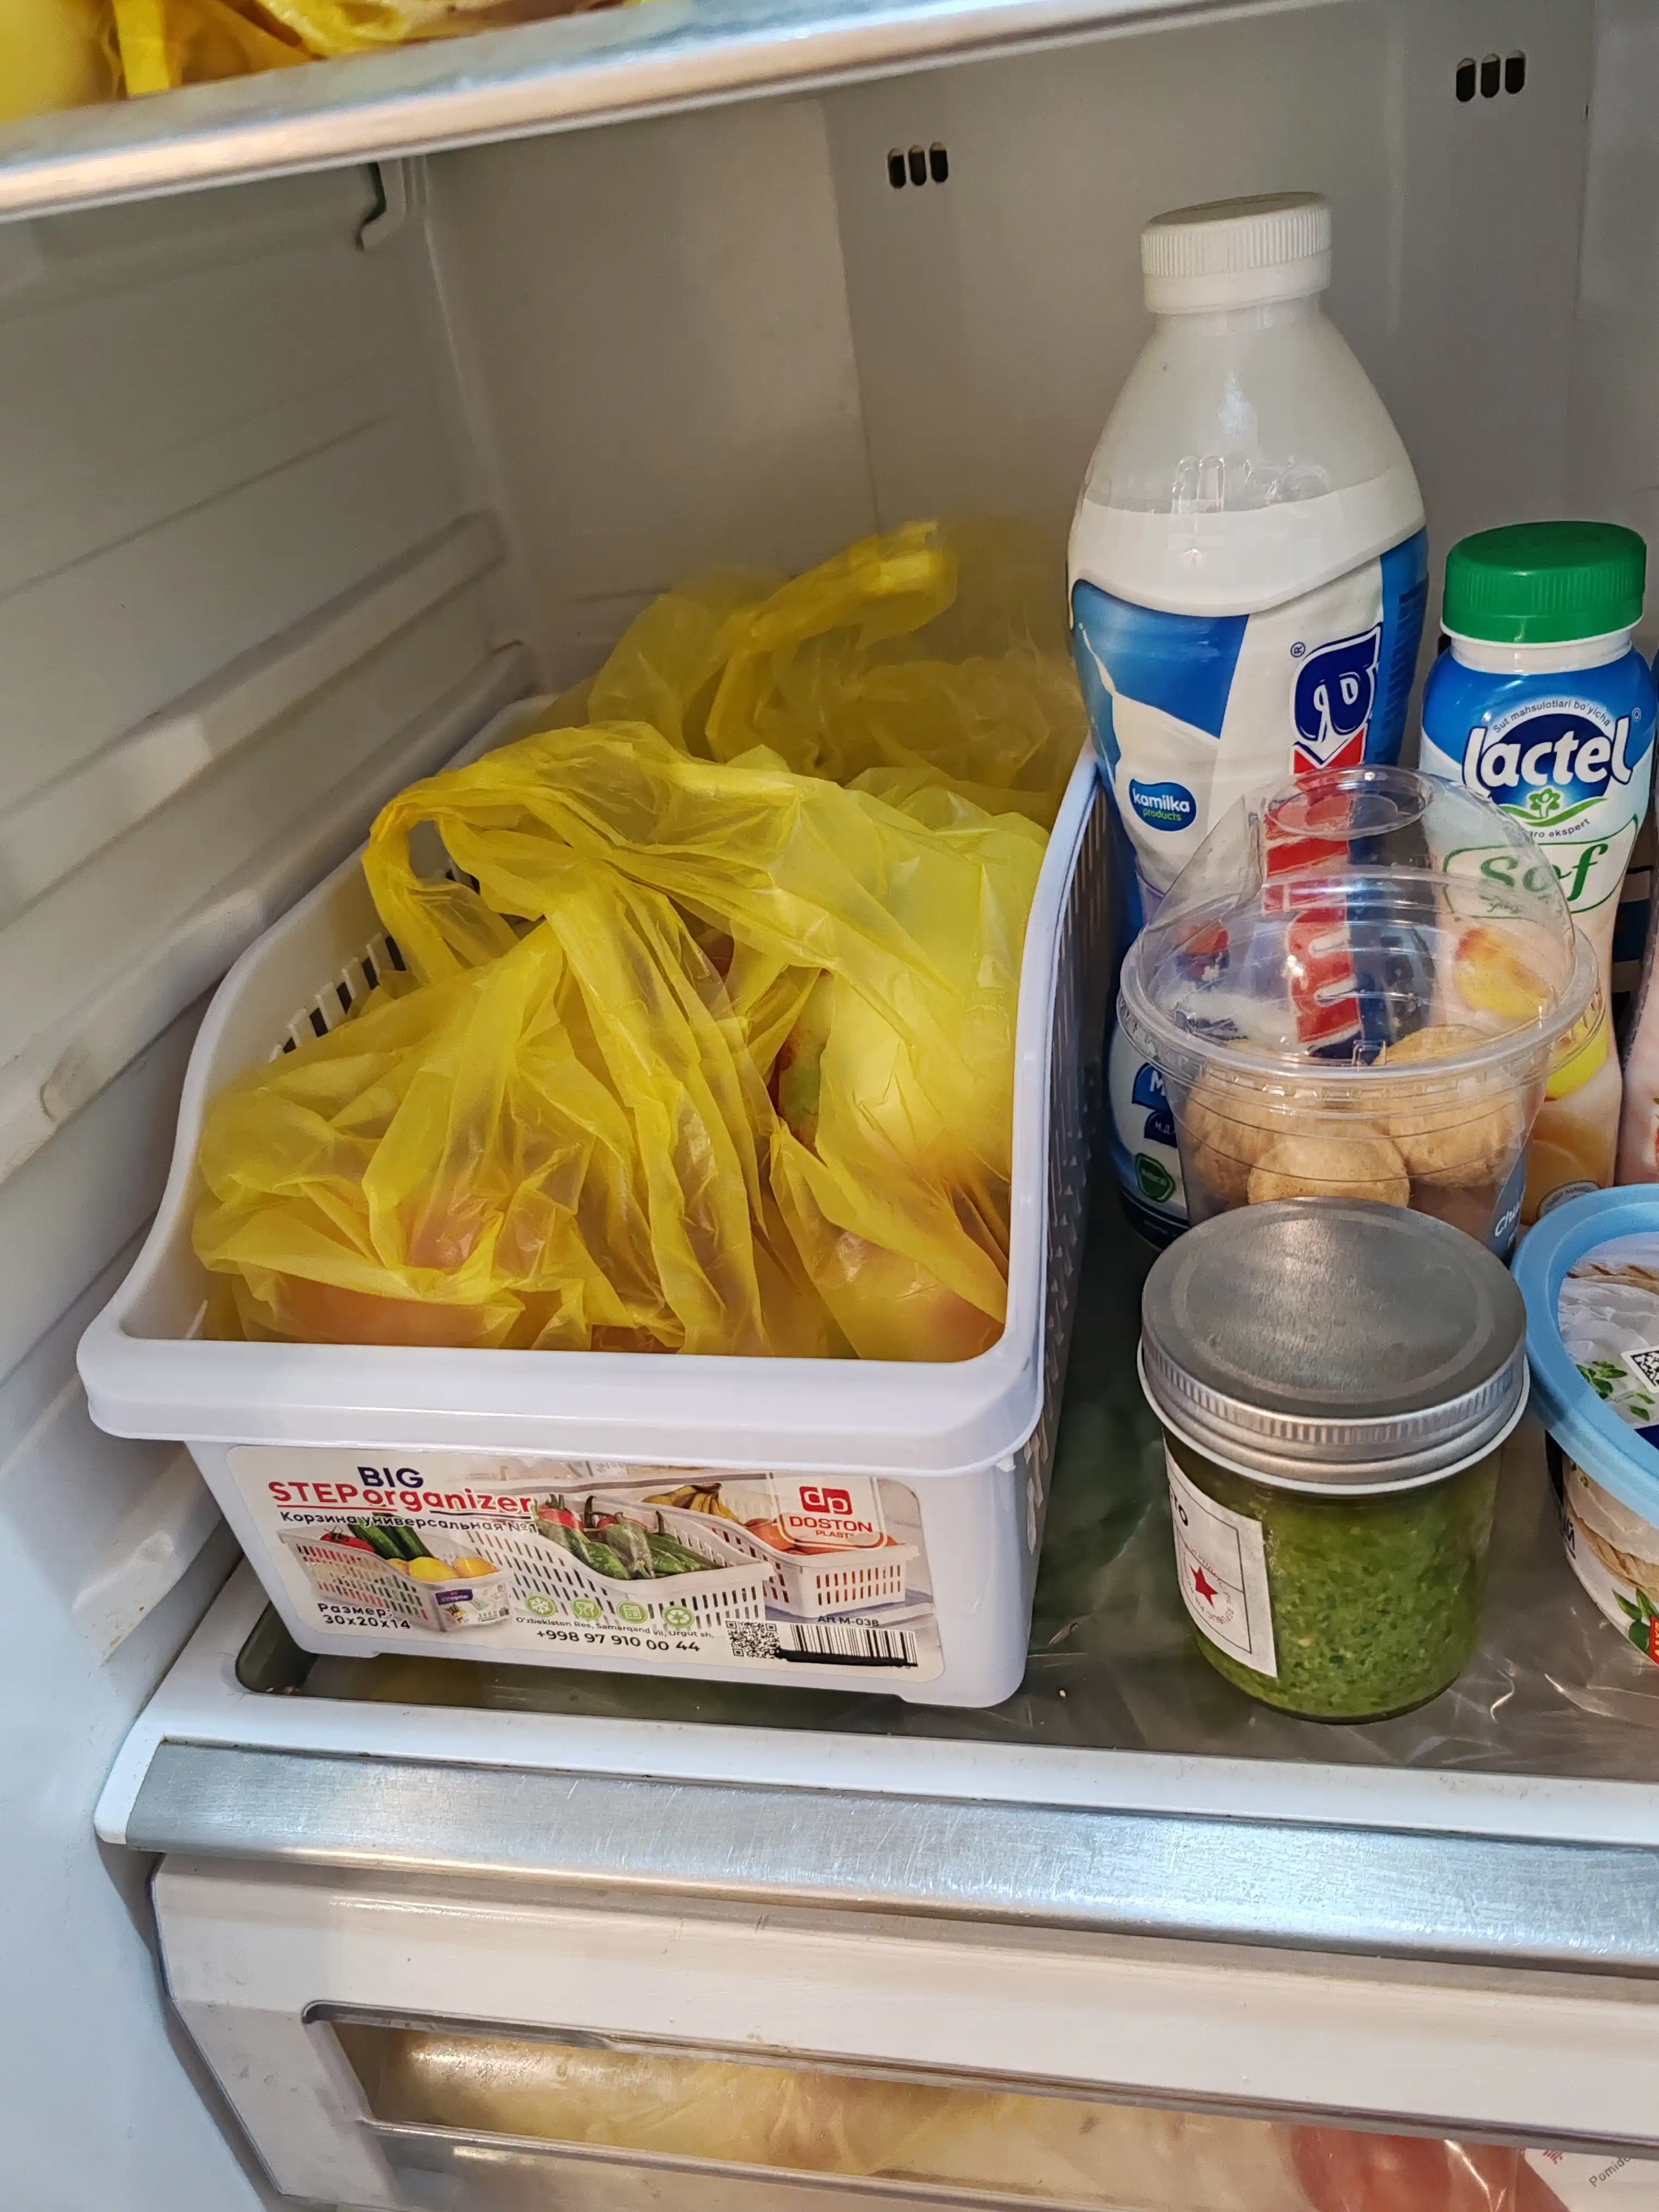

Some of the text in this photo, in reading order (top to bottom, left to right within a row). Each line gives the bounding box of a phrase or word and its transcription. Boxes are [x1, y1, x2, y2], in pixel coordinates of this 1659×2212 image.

[1493, 717, 1510, 734] Sut
[1510, 699, 1571, 721] mahsulotlari
[1463, 714, 1635, 797] lactel
[1132, 788, 1190, 813] kamilka
[1143, 808, 1182, 822] products
[1549, 818, 1590, 838] ekspert
[1480, 843, 1609, 902] Sof
[357, 1466, 424, 1489] BIG
[280, 1511, 358, 1525] Корзина
[361, 1514, 504, 1532] универсальная
[789, 1516, 873, 1533] DOSTON
[815, 1529, 850, 1539] PLAST
[317, 1602, 394, 1618] Размер:
[515, 1616, 572, 1627] O'zbekiston
[595, 1622, 651, 1635] Samarqand
[818, 1615, 880, 1627] Art M-038
[536, 1629, 701, 1652] +998 97 910 00 44
